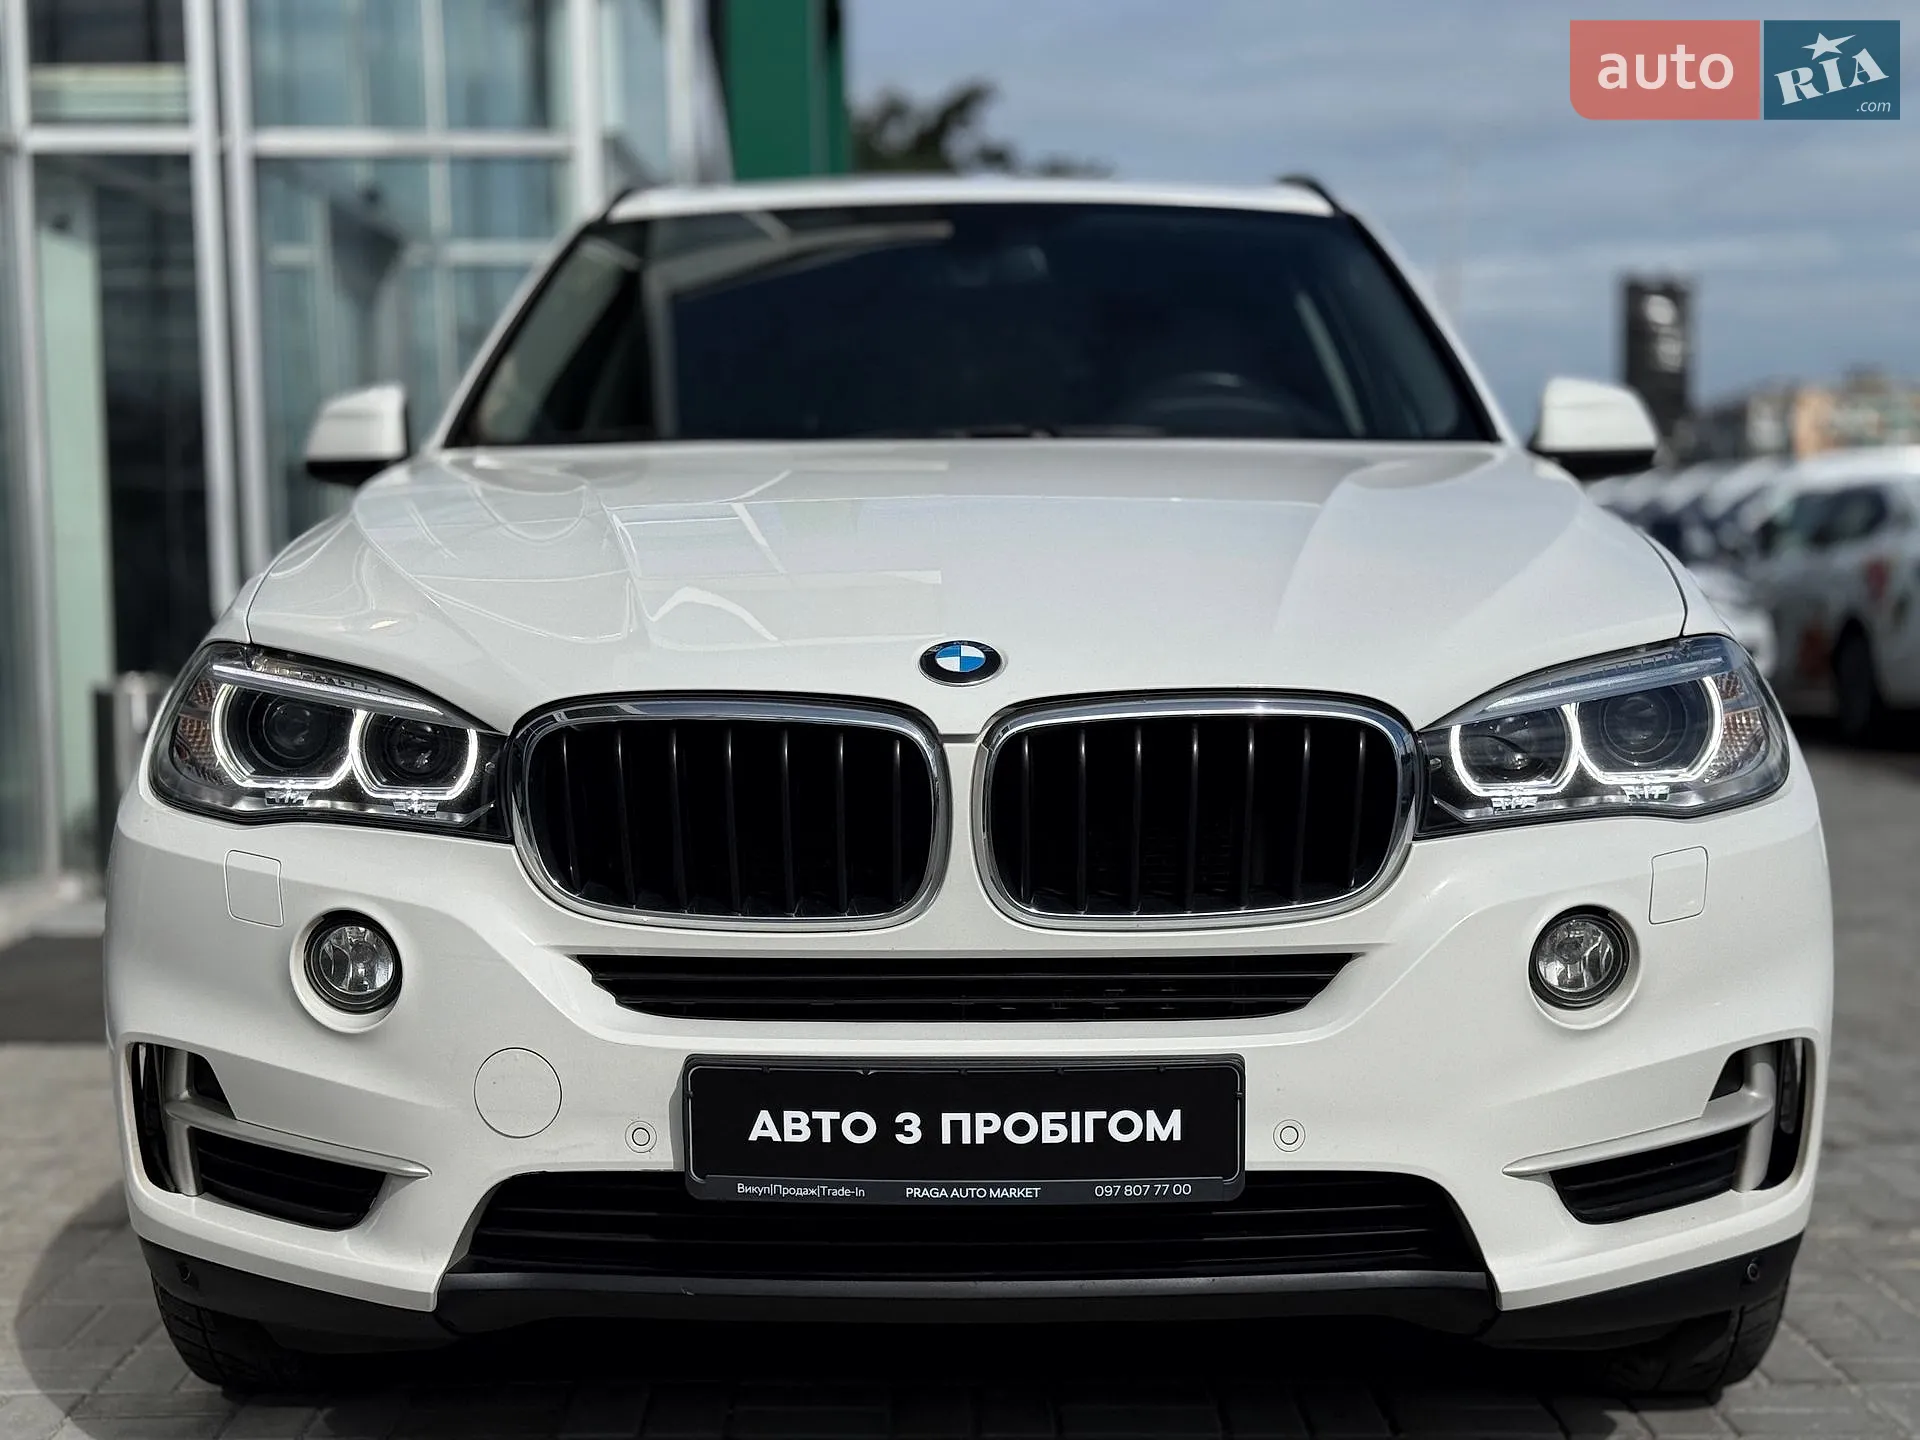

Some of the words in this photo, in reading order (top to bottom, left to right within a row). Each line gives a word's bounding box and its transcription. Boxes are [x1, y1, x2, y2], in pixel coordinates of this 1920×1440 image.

[747, 1109, 877, 1144] АВТО
[941, 1108, 1182, 1145] ПРОБІГОМ
[905, 1187, 949, 1199] PRAGA
[950, 1187, 987, 1199] AUTO
[989, 1187, 1042, 1199] MARKET
[1094, 1184, 1121, 1197] 097
[1123, 1184, 1150, 1197] 807
[1153, 1184, 1170, 1196] 77
[1172, 1183, 1192, 1196] 00
